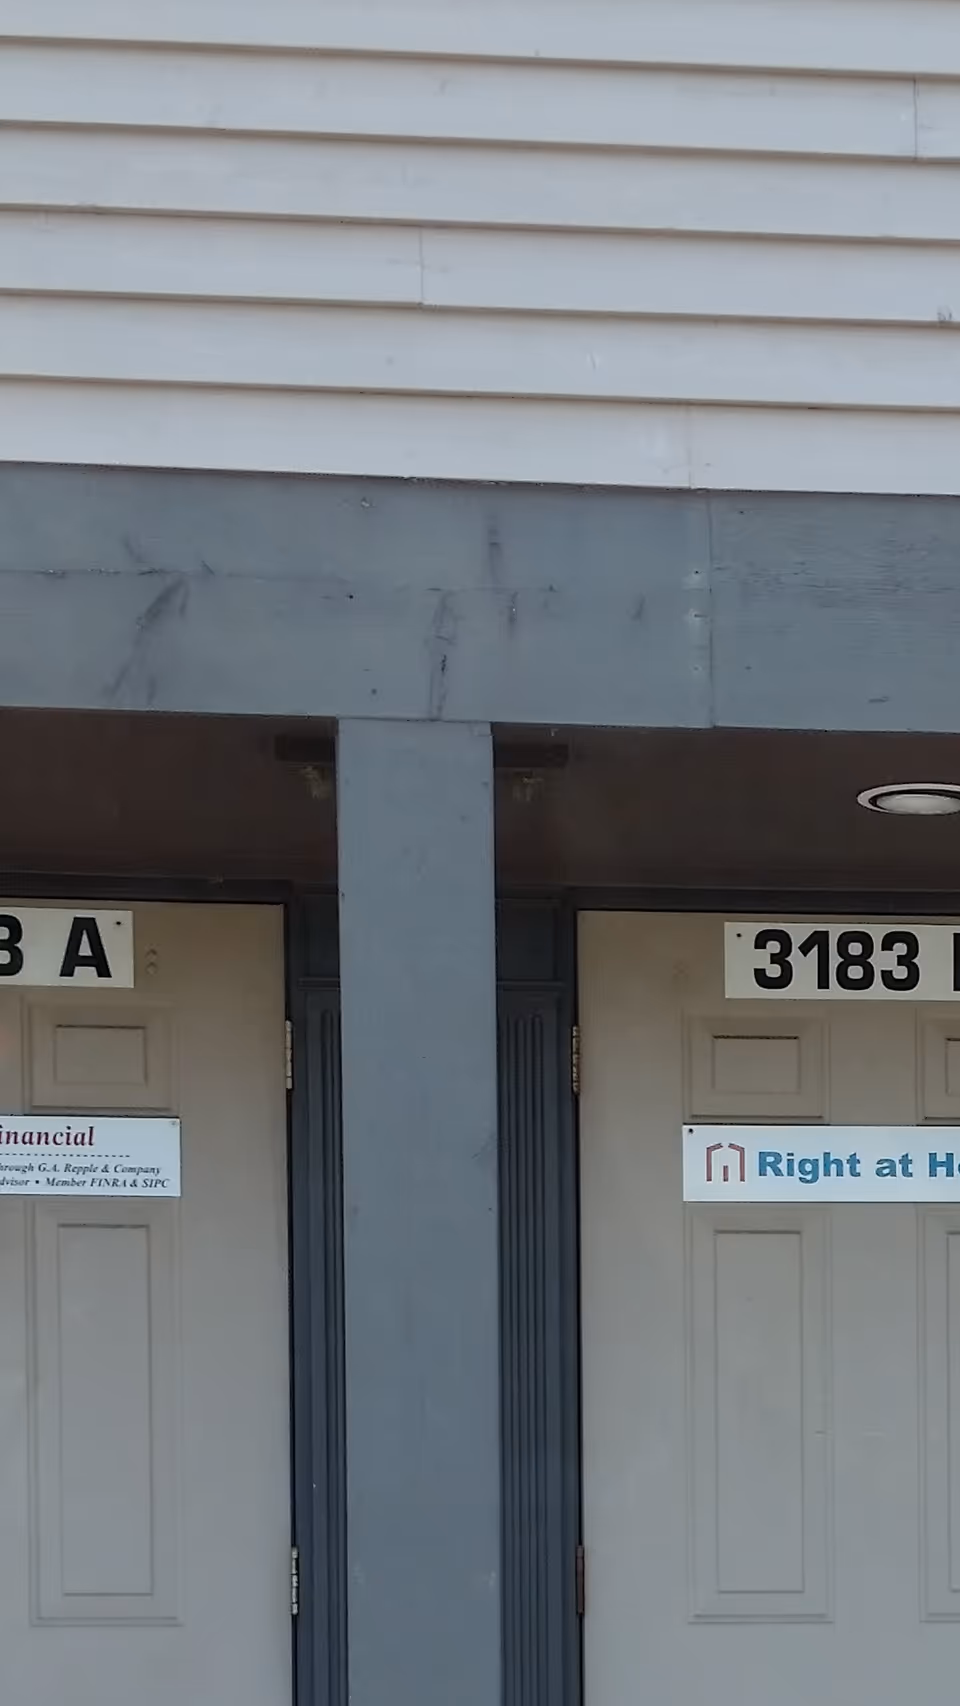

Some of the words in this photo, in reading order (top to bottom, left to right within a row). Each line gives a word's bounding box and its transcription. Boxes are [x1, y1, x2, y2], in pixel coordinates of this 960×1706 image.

[59, 916, 113, 979] A
[753, 929, 920, 992] 3183
[46, 1177, 87, 1187] Member
[90, 1178, 127, 1188] FINRA
[129, 1178, 138, 1188] &
[142, 1178, 171, 1189] SIPC
[64, 1163, 99, 1176] Repple
[101, 1164, 110, 1174] &
[114, 1164, 162, 1177] Company
[757, 1151, 862, 1185] Right
[875, 1153, 914, 1179] at
